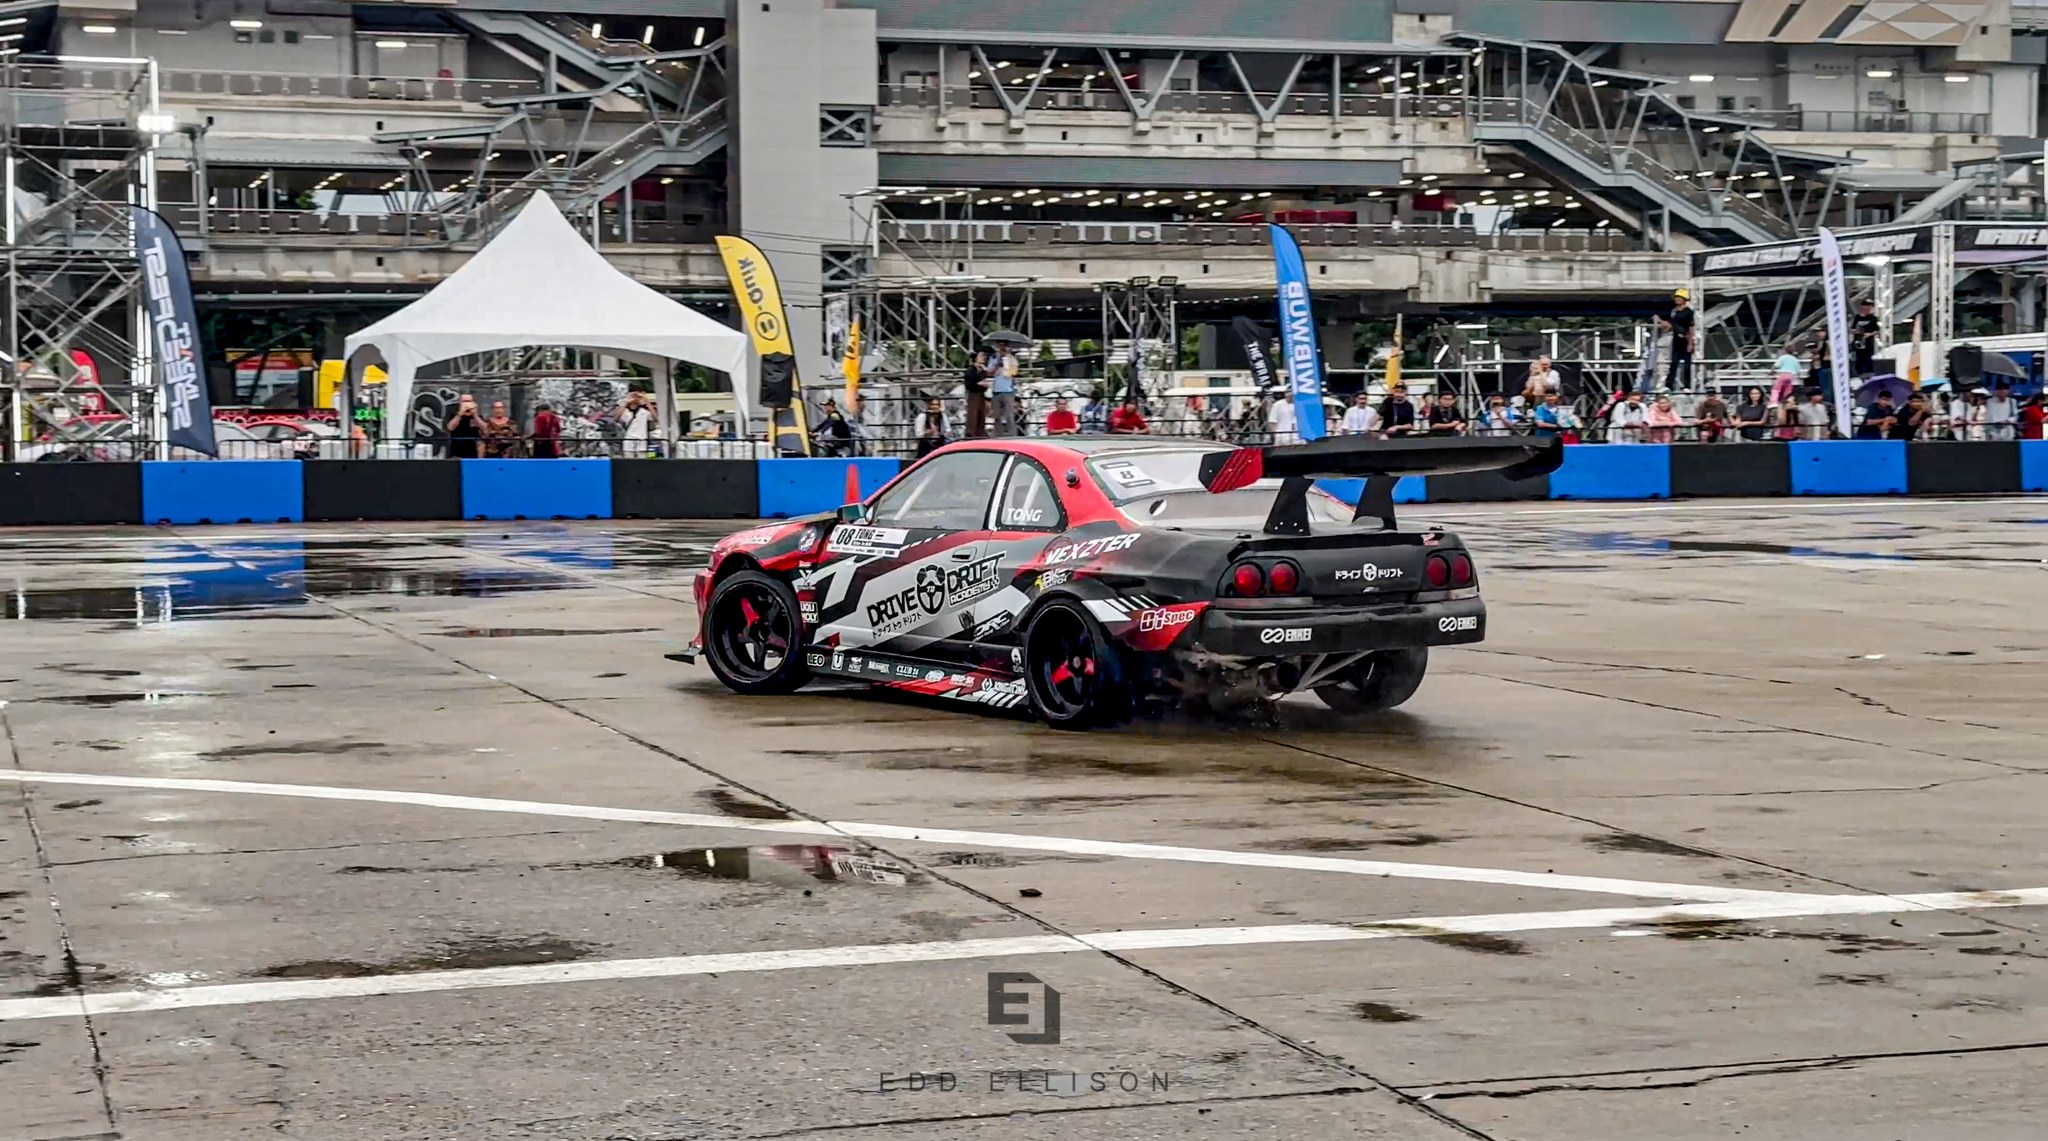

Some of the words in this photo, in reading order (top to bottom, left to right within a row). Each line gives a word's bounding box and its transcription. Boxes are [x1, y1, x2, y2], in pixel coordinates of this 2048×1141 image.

[1120, 470, 1135, 480] 8
[1007, 508, 1042, 522] TONG
[836, 528, 856, 545] 08
[855, 528, 876, 540] TONG
[867, 586, 919, 628] DRIVE
[946, 551, 1006, 595] DRIFT
[807, 653, 825, 667] LEO
